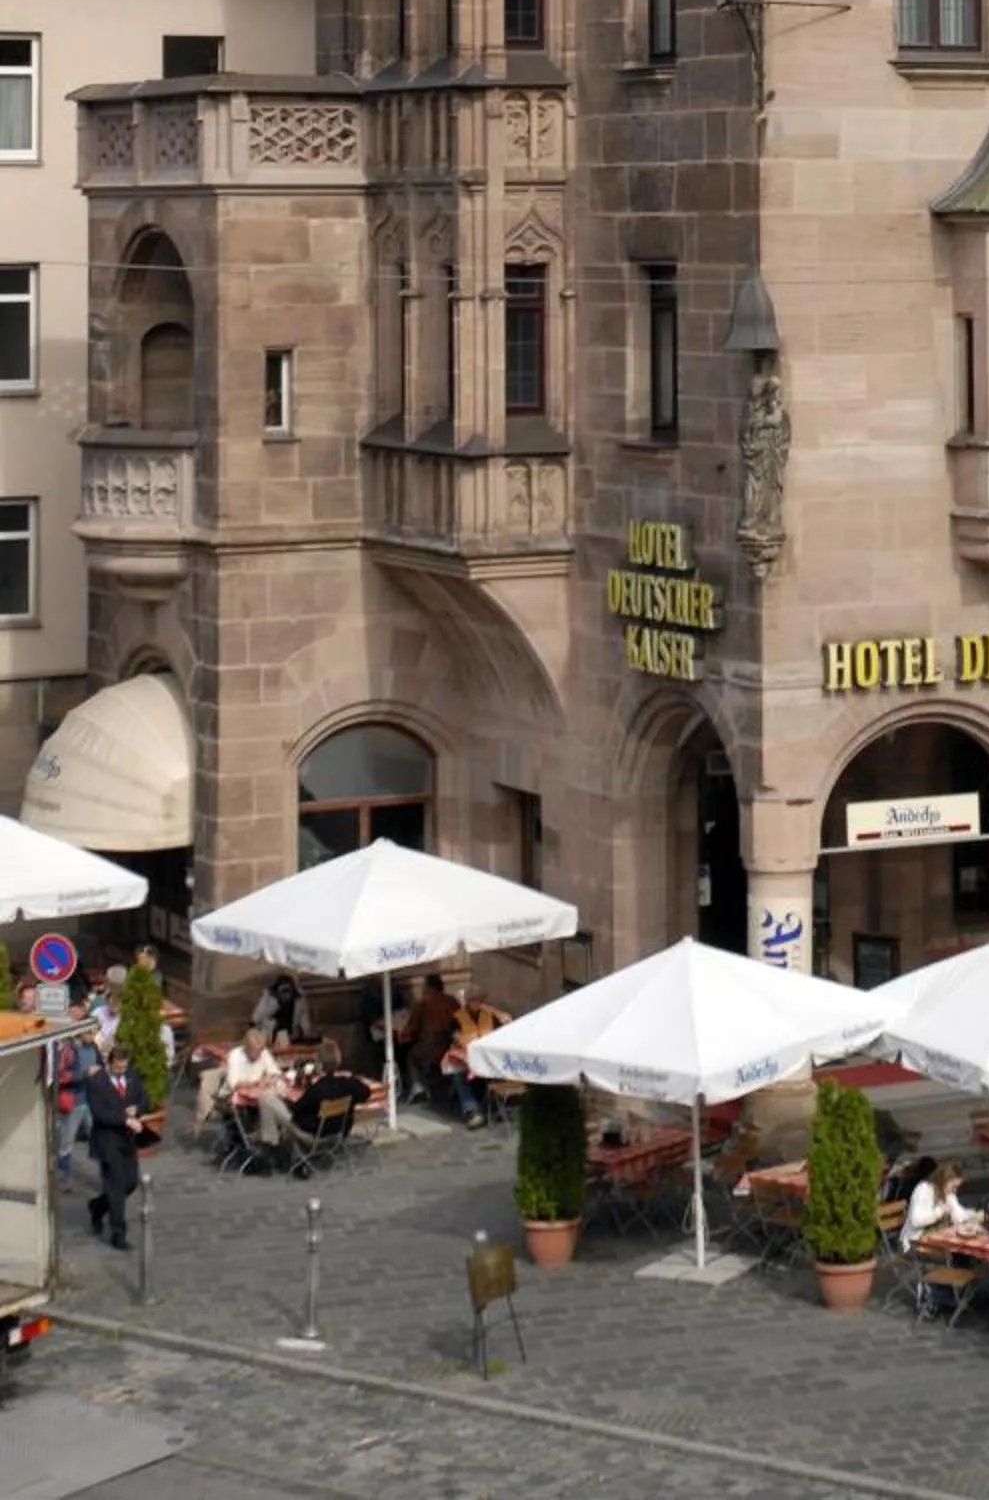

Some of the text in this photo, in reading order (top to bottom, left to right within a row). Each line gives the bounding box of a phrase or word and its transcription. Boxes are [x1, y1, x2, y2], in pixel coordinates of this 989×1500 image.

[629, 520, 687, 569] HOTEL
[607, 569, 715, 629] DEUTSCHER
[626, 624, 696, 681] KAISER
[827, 638, 943, 689] HOTEL
